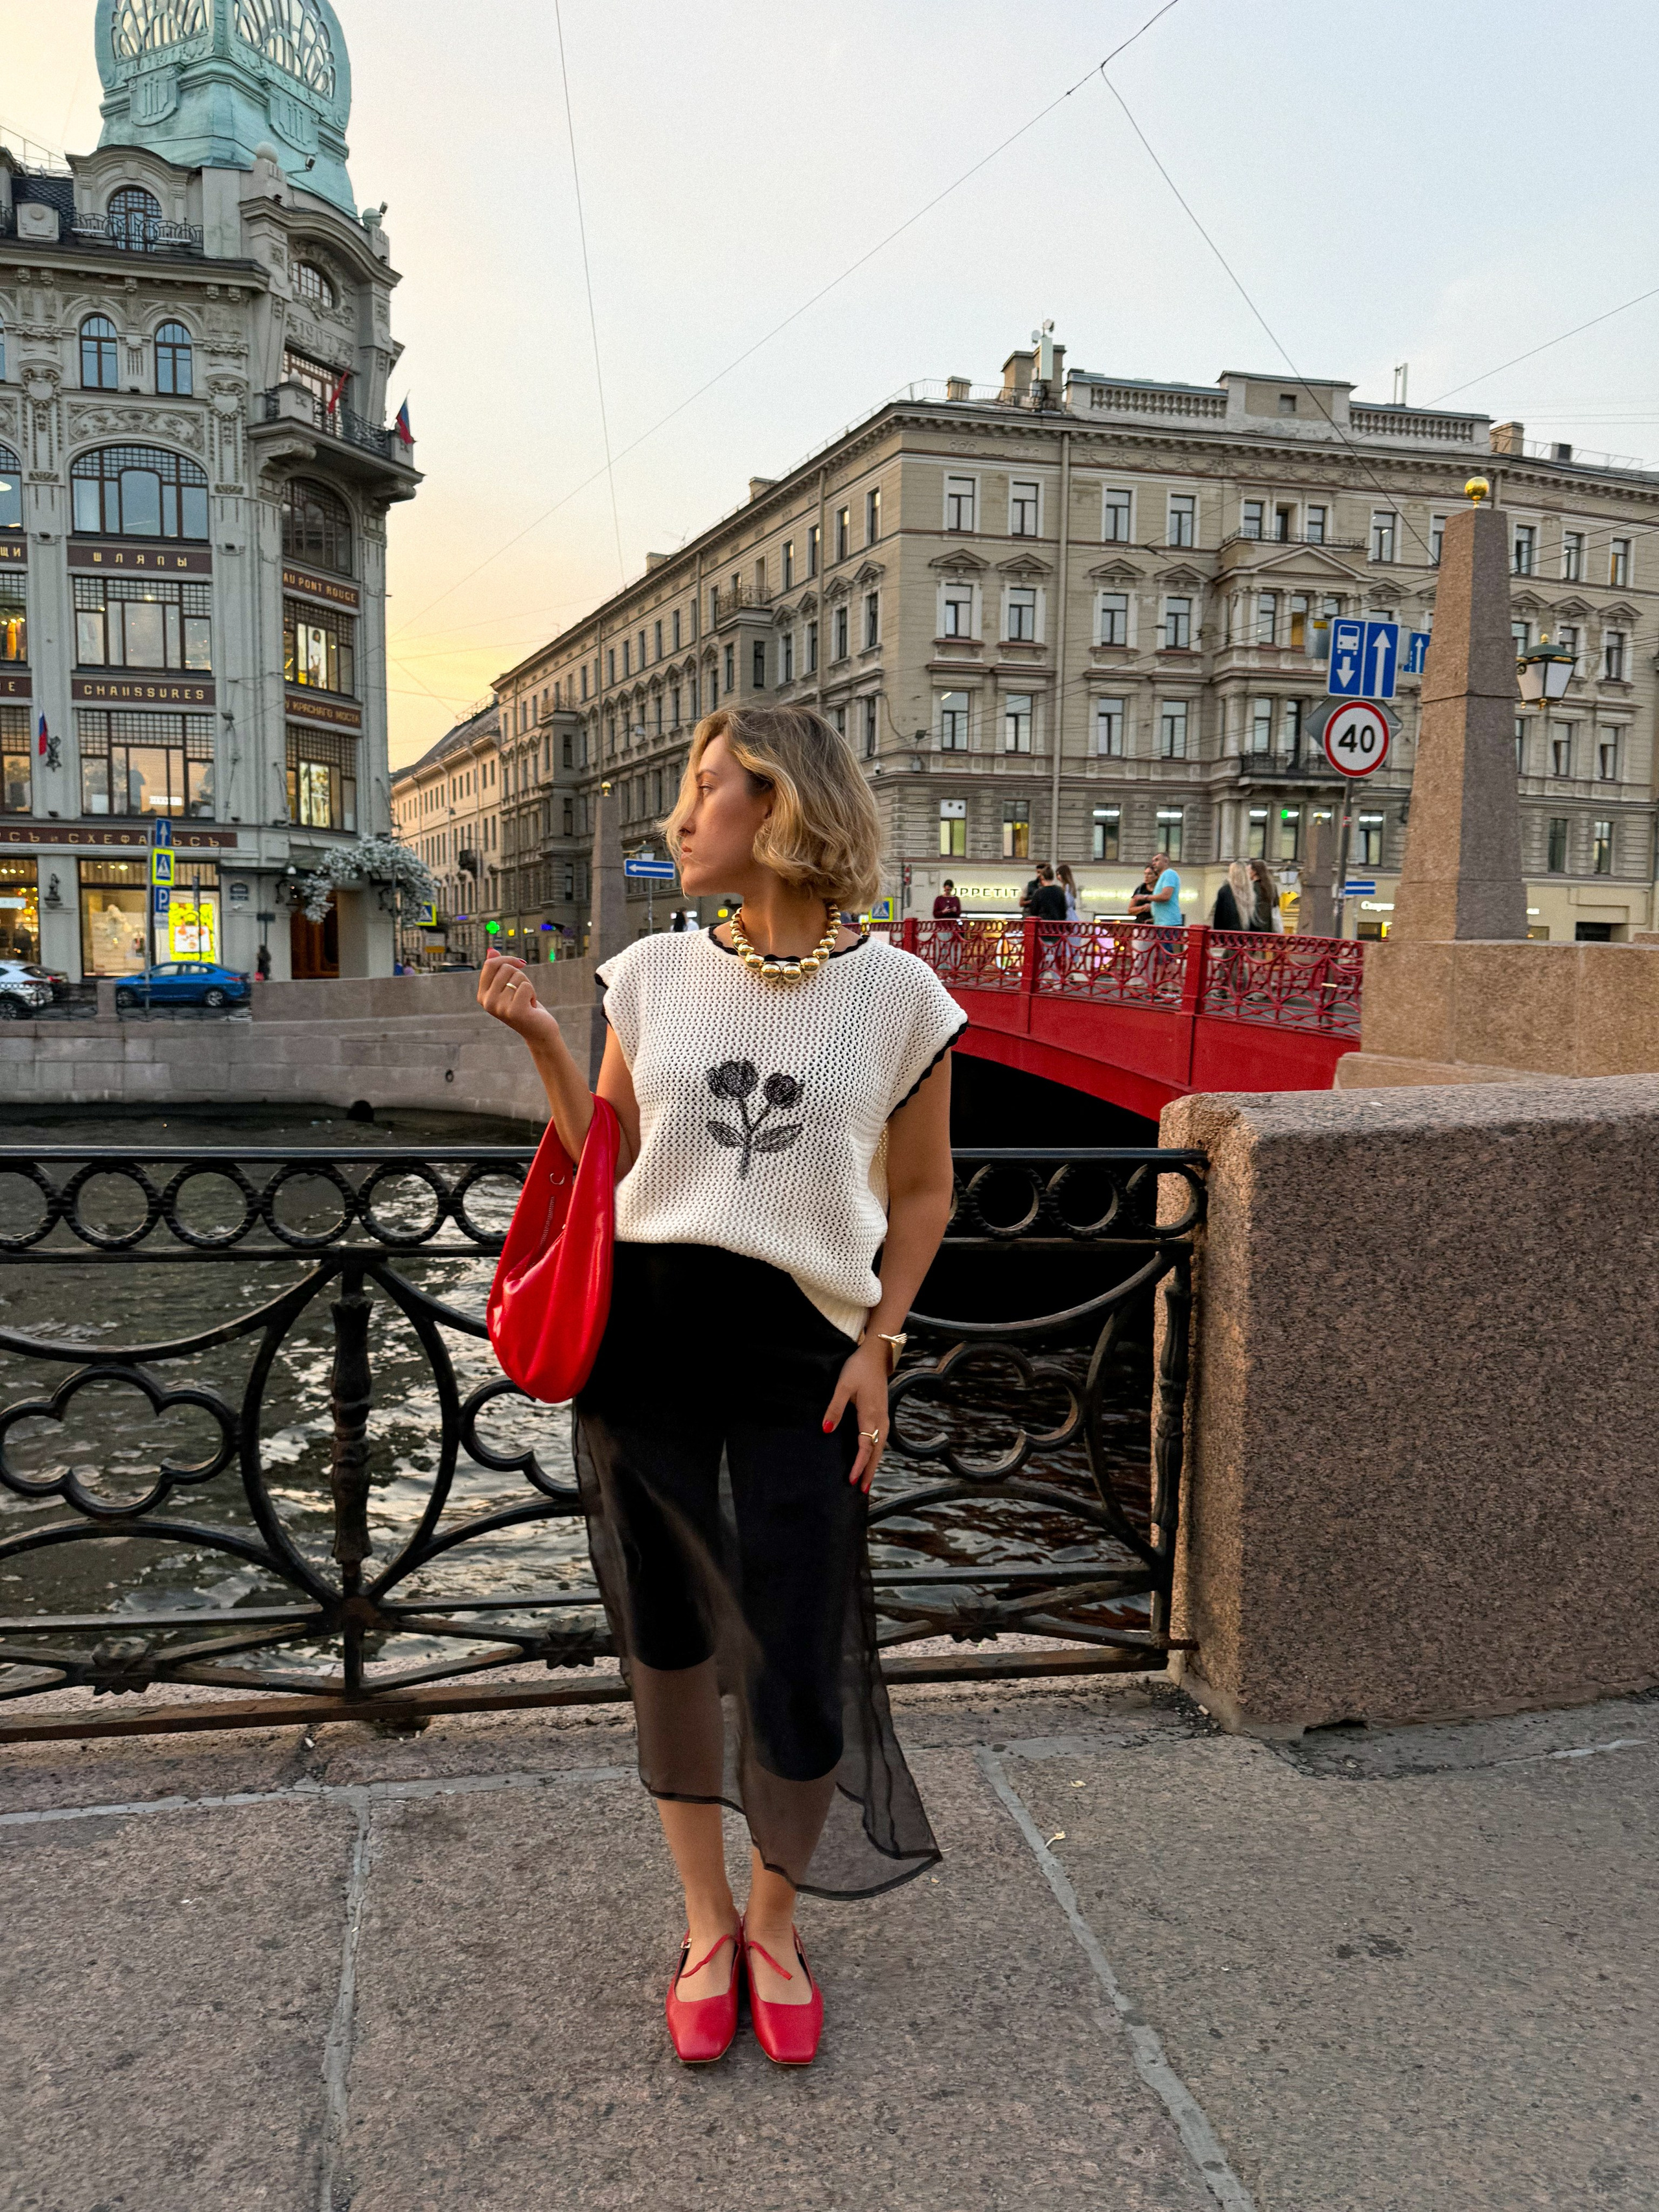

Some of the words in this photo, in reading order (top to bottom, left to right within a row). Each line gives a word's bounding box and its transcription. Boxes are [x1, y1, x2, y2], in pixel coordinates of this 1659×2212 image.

[93, 552, 187, 568] ШЛЯПЫ
[283, 572, 296, 584] AU
[298, 577, 322, 592] PONT
[326, 586, 356, 603] ROUGE
[84, 684, 204, 700] CHAUSSURES
[1338, 724, 1375, 753] 40
[68, 833, 220, 847] СХЕФАЬСЪ
